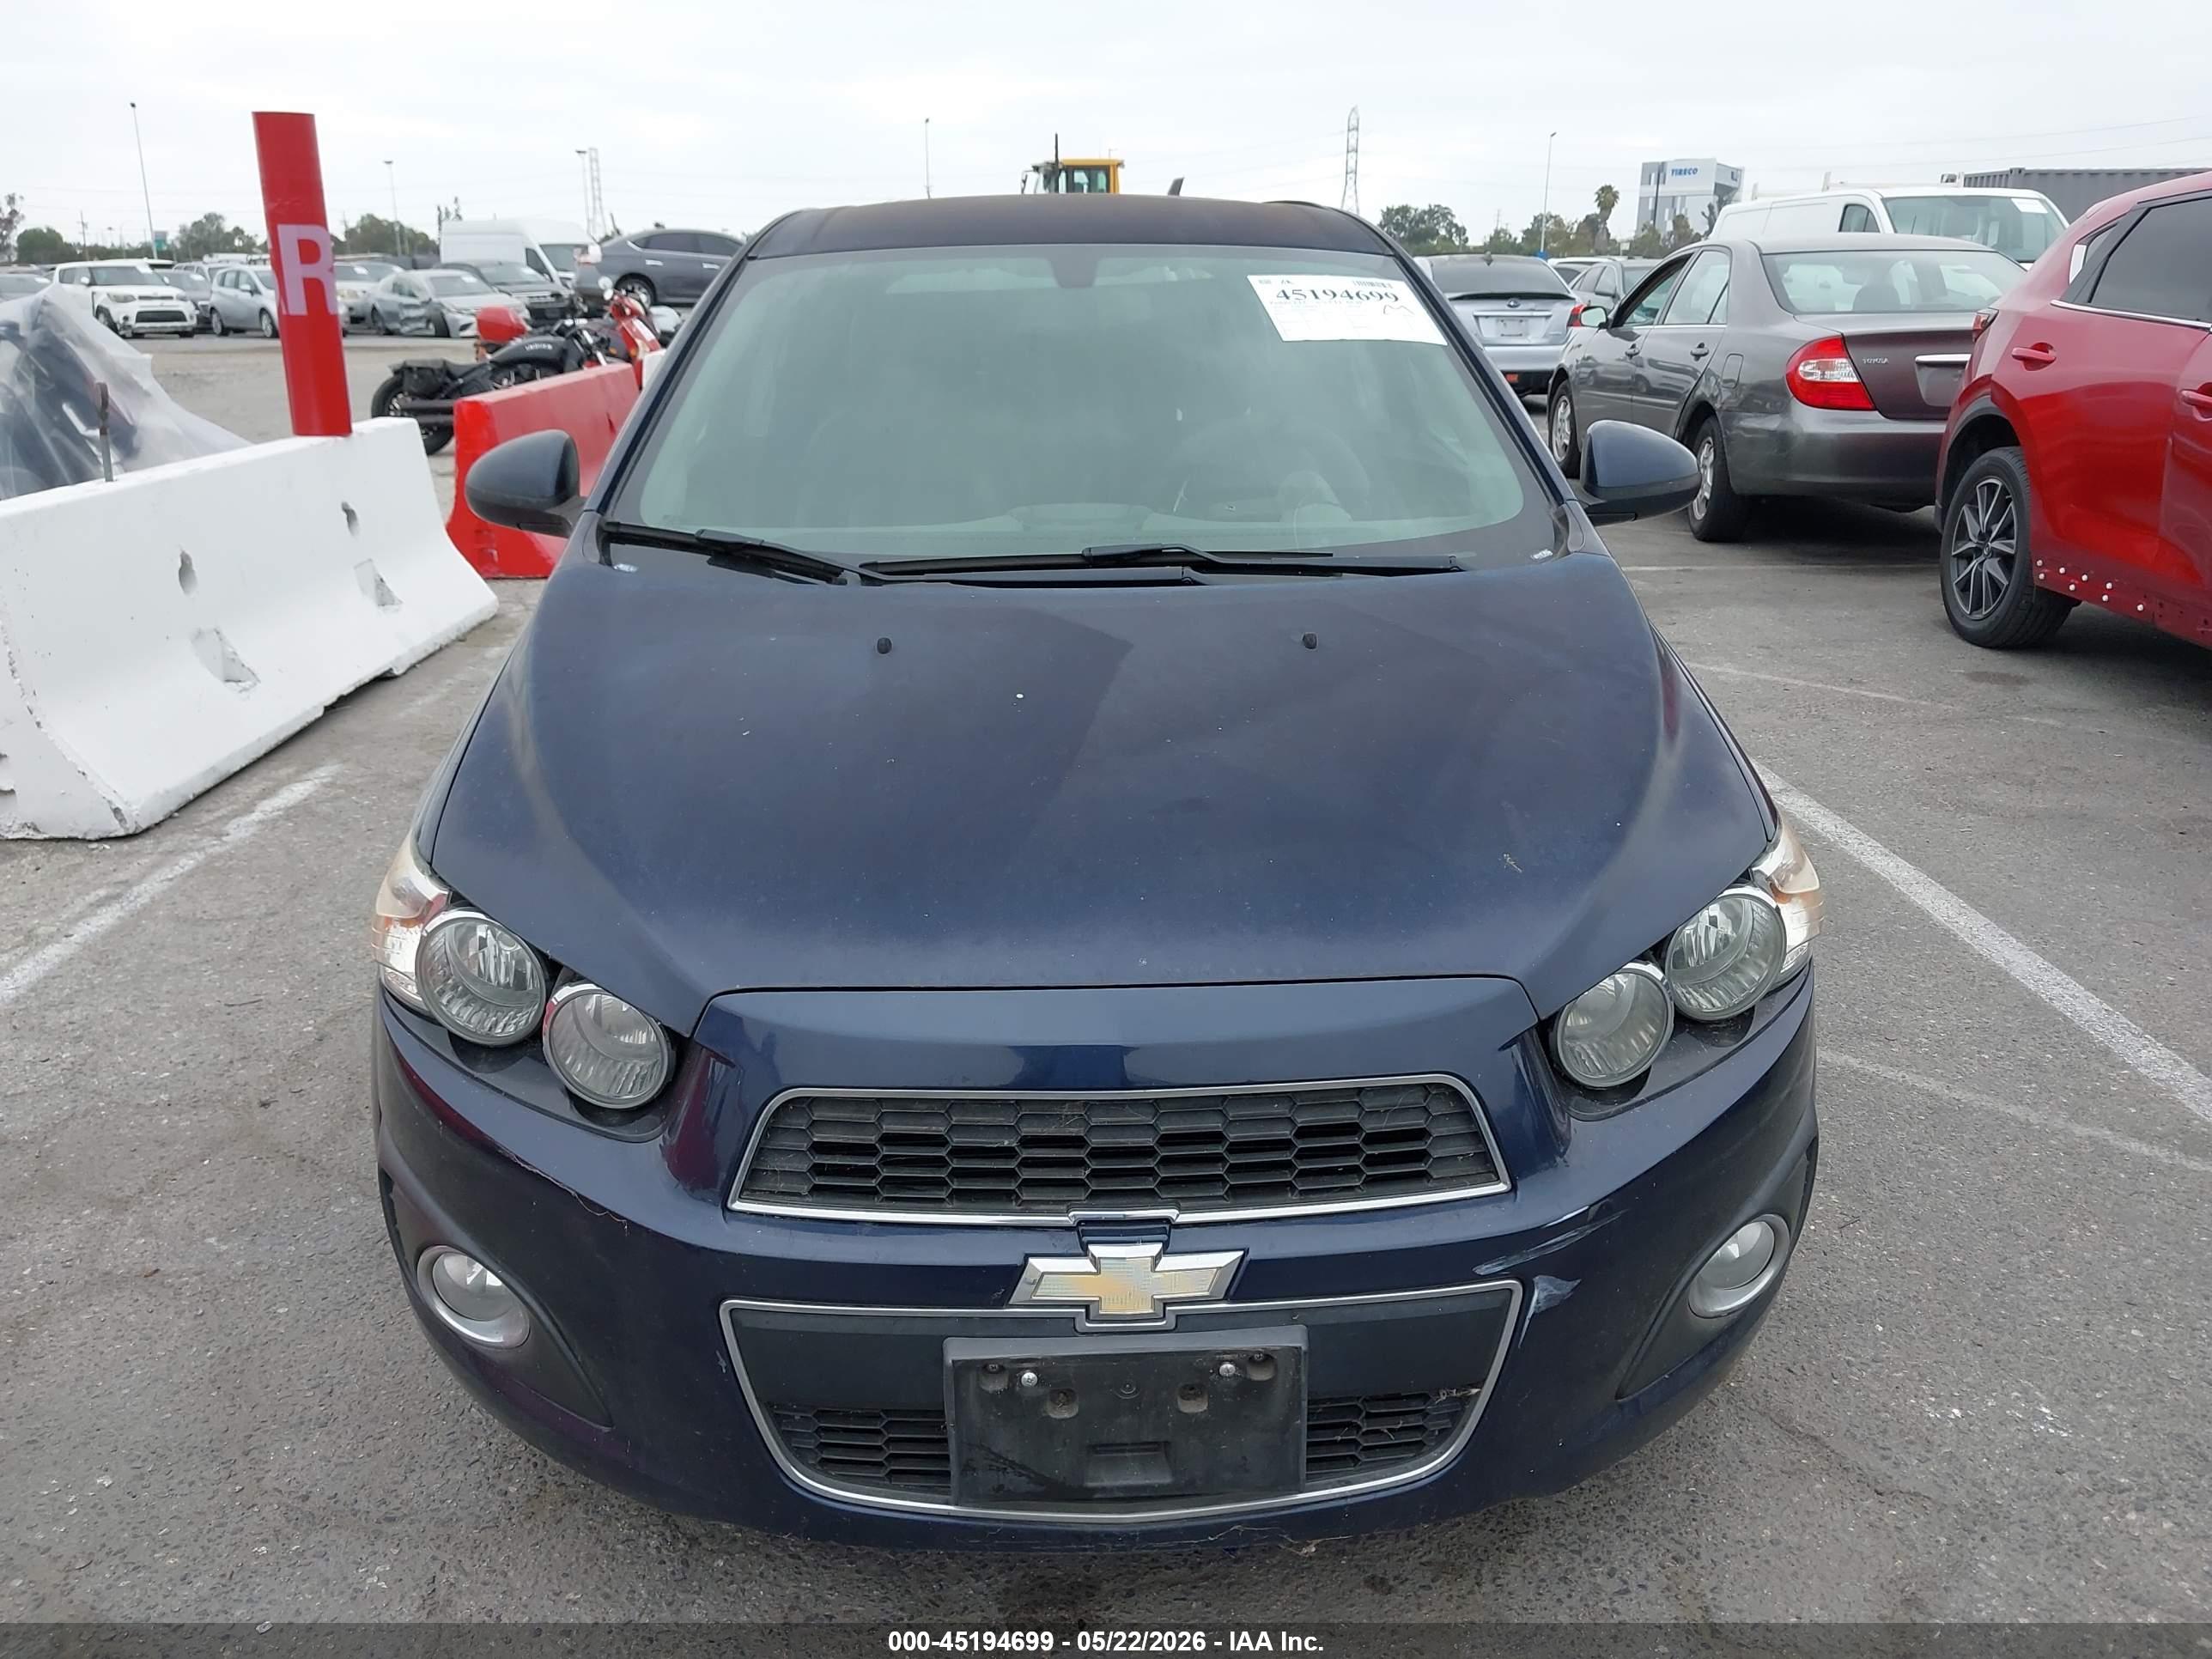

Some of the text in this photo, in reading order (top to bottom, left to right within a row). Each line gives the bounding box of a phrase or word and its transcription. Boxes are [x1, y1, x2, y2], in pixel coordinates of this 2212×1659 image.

[1671, 167, 1698, 177] TIRECO
[277, 224, 338, 315] R
[1276, 288, 1400, 302] 45194699
